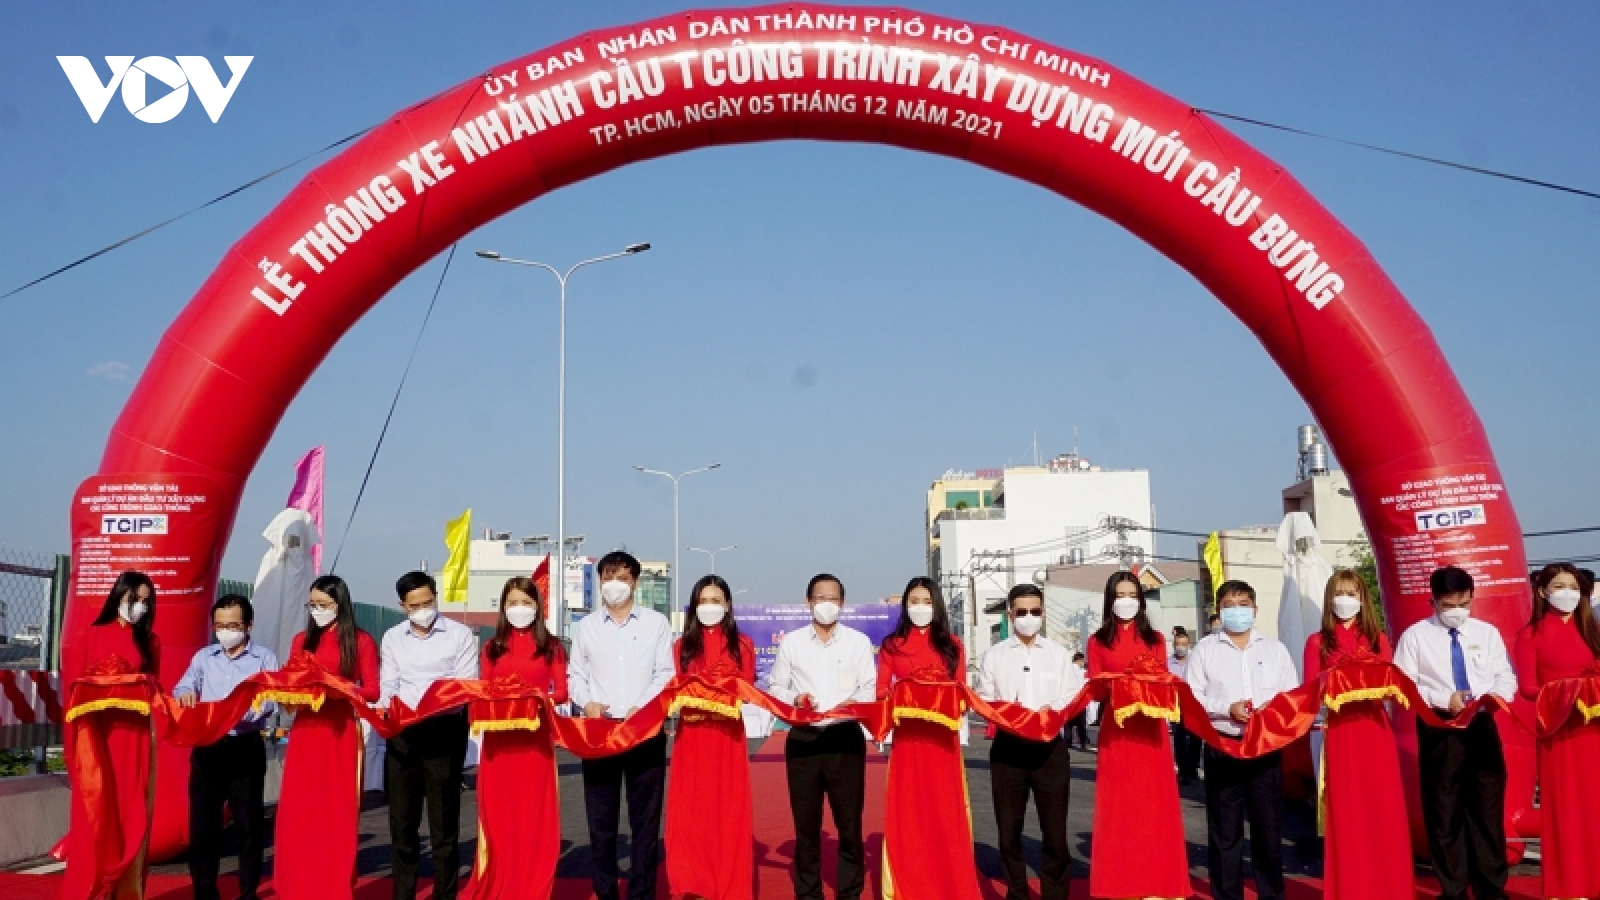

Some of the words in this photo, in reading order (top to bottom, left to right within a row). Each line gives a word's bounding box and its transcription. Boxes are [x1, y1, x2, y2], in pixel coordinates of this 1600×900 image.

[526, 47, 585, 81] BAN
[597, 26, 677, 60] NHÂN
[688, 16, 750, 39] DÂN
[753, 10, 857, 31] THÀNH
[863, 16, 926, 37] PHỐ
[932, 23, 975, 45] HỒ
[980, 35, 1032, 61] CHÍ
[1033, 50, 1111, 88] MINH
[589, 123, 621, 146] TP.
[624, 110, 682, 138] HCM,
[683, 95, 744, 124] NGÀY
[749, 95, 775, 114] 05
[777, 90, 857, 114] THÁNG
[863, 96, 888, 116] 12
[895, 99, 949, 126] NĂM
[951, 109, 1004, 140] 2021
[251, 255, 307, 317] LỄ
[288, 175, 407, 274] THÔNG
[396, 139, 457, 196] XE
[451, 79, 585, 165] NHÁNH
[589, 57, 666, 110] CẦU
[703, 38, 805, 87] CÔNG
[813, 36, 922, 87] TRÌNH
[928, 53, 1006, 103] XÂY
[1005, 73, 1115, 142] DỰNG
[1110, 117, 1191, 182] MỚI
[1183, 165, 1263, 227] CẦU
[1248, 213, 1345, 311] BƯNG
[104, 517, 154, 533] TCIP
[1418, 509, 1473, 529] TCIP
